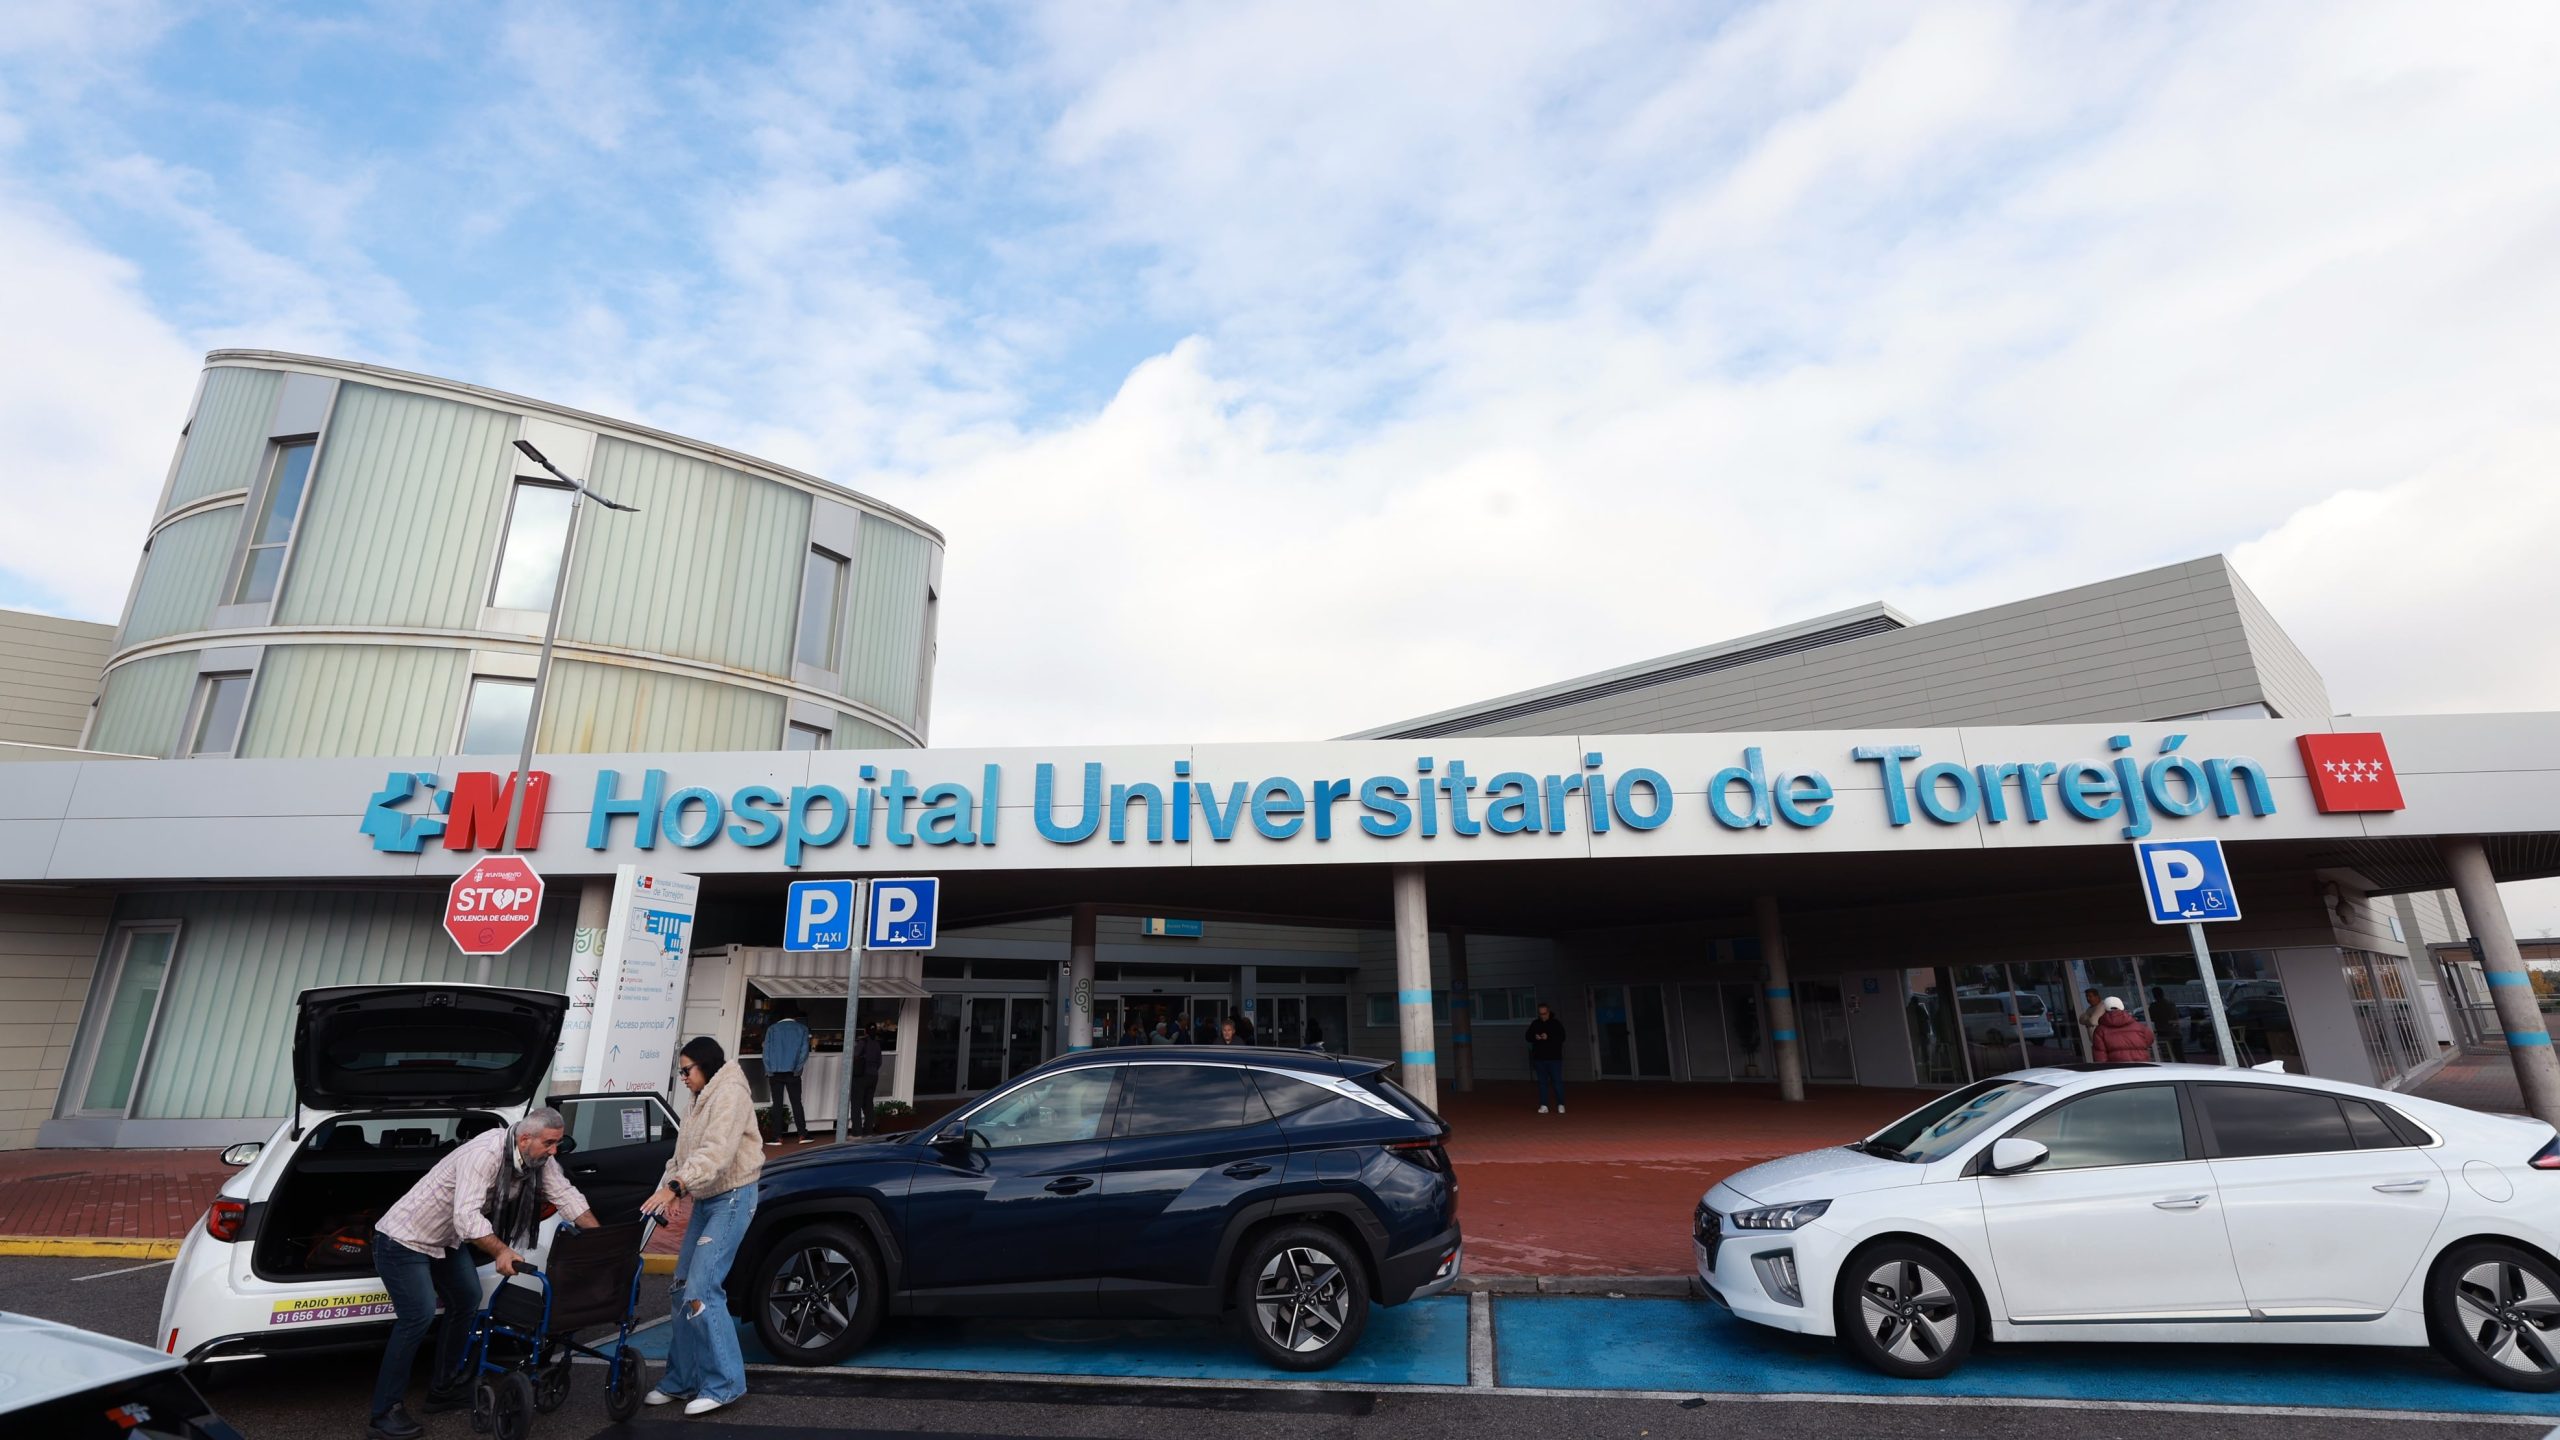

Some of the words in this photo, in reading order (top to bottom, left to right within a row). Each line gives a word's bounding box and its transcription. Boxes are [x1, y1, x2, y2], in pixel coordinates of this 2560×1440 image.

[586, 763, 1000, 867] Hospital
[1034, 752, 1673, 844] Universitario
[1707, 747, 1834, 829] de
[1852, 734, 2277, 839] Torrejón
[2149, 849, 2204, 913] P
[2190, 902, 2197, 911] 2
[453, 914, 488, 922] VIOLENCIA
[489, 914, 499, 922] DE
[500, 913, 529, 922] GÉNERO
[797, 889, 839, 943] P
[875, 887, 918, 941] P
[815, 932, 841, 943] TAXI
[894, 930, 900, 938] 2
[563, 1019, 592, 1030] GRACIA
[614, 1019, 639, 1029] Acceso
[639, 1019, 665, 1031] principal
[294, 1298, 329, 1309] RADIO
[332, 1296, 356, 1306] TAXI
[276, 1313, 289, 1323] 91
[291, 1310, 313, 1321] 656
[316, 1308, 331, 1319] 40
[334, 1307, 348, 1318] 30
[360, 1304, 373, 1315] 91
[375, 1303, 395, 1313] 675
